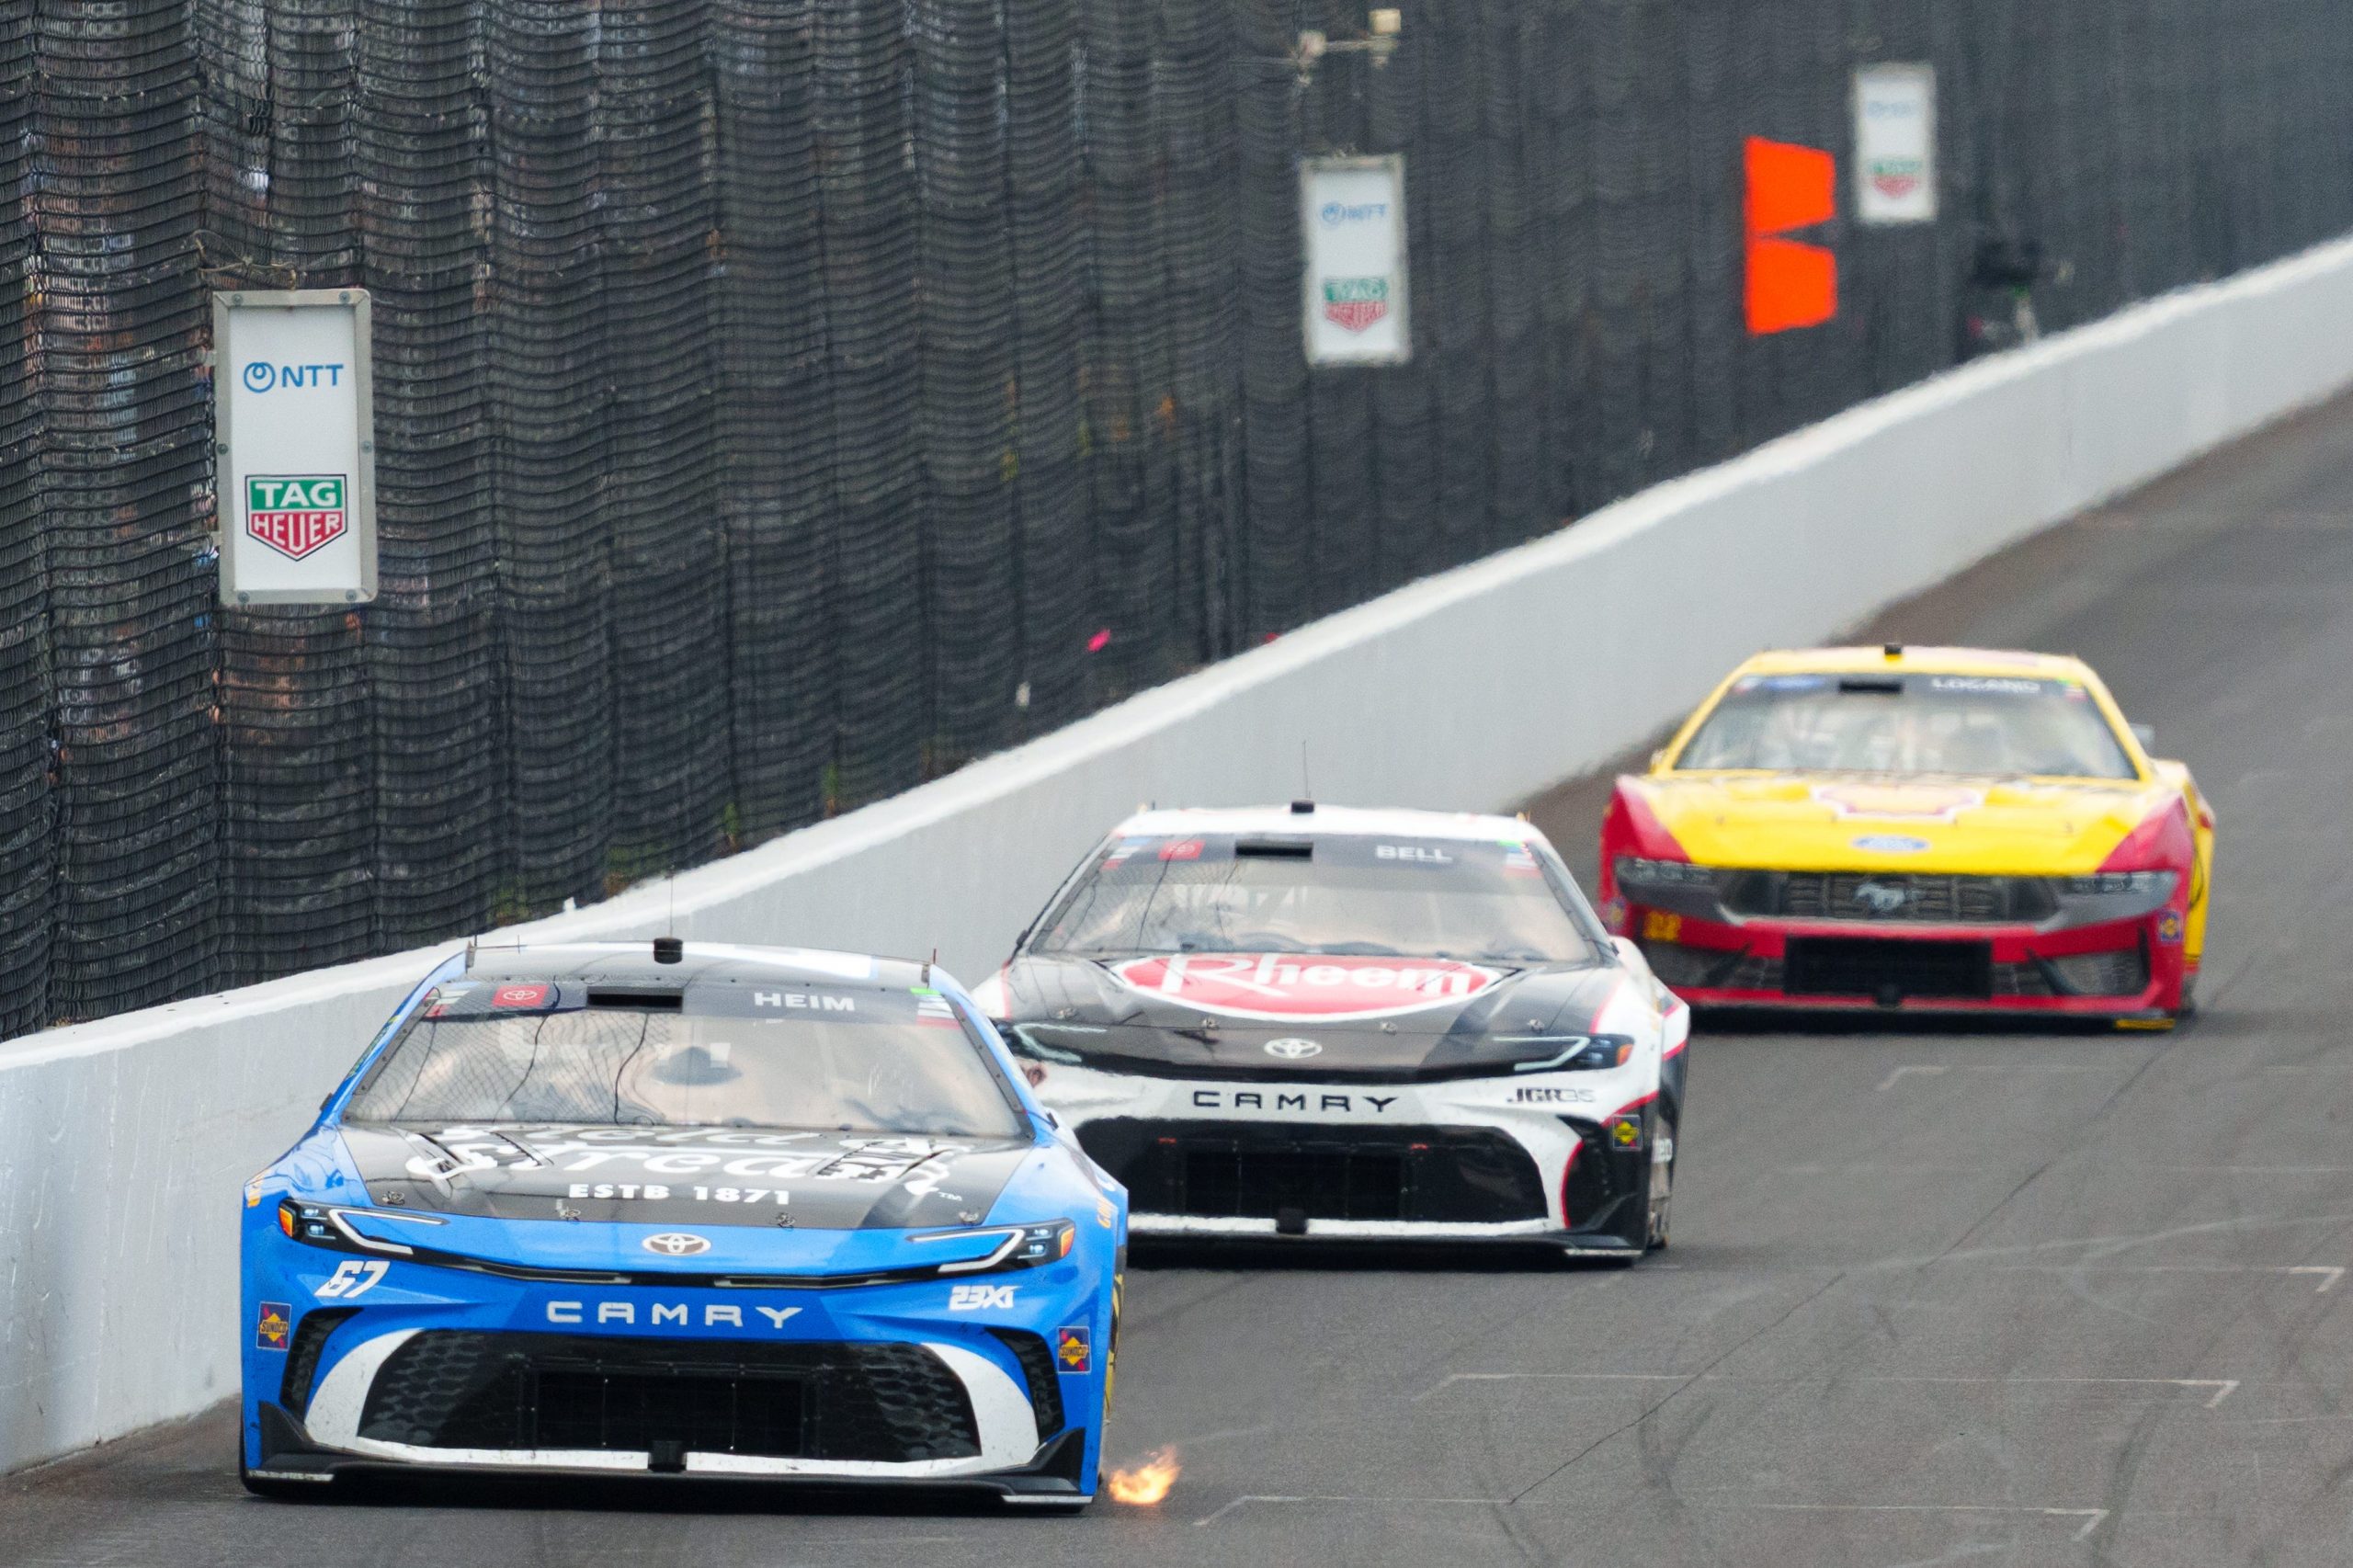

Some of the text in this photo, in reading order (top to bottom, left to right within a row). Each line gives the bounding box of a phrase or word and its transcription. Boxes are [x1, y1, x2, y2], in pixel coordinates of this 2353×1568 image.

[281, 364, 344, 387] NTT
[255, 482, 336, 507] TAG
[254, 513, 340, 551] HEUER
[1376, 845, 1452, 863] BELL
[1161, 953, 1472, 996] Rheem
[754, 992, 856, 1011] HEIM
[1193, 1091, 1398, 1112] CAMRY
[569, 1183, 790, 1205] ESTB 1871
[313, 1260, 391, 1298] 67
[547, 1301, 803, 1329] CAMRY
[260, 1321, 289, 1334] SUNOCO
